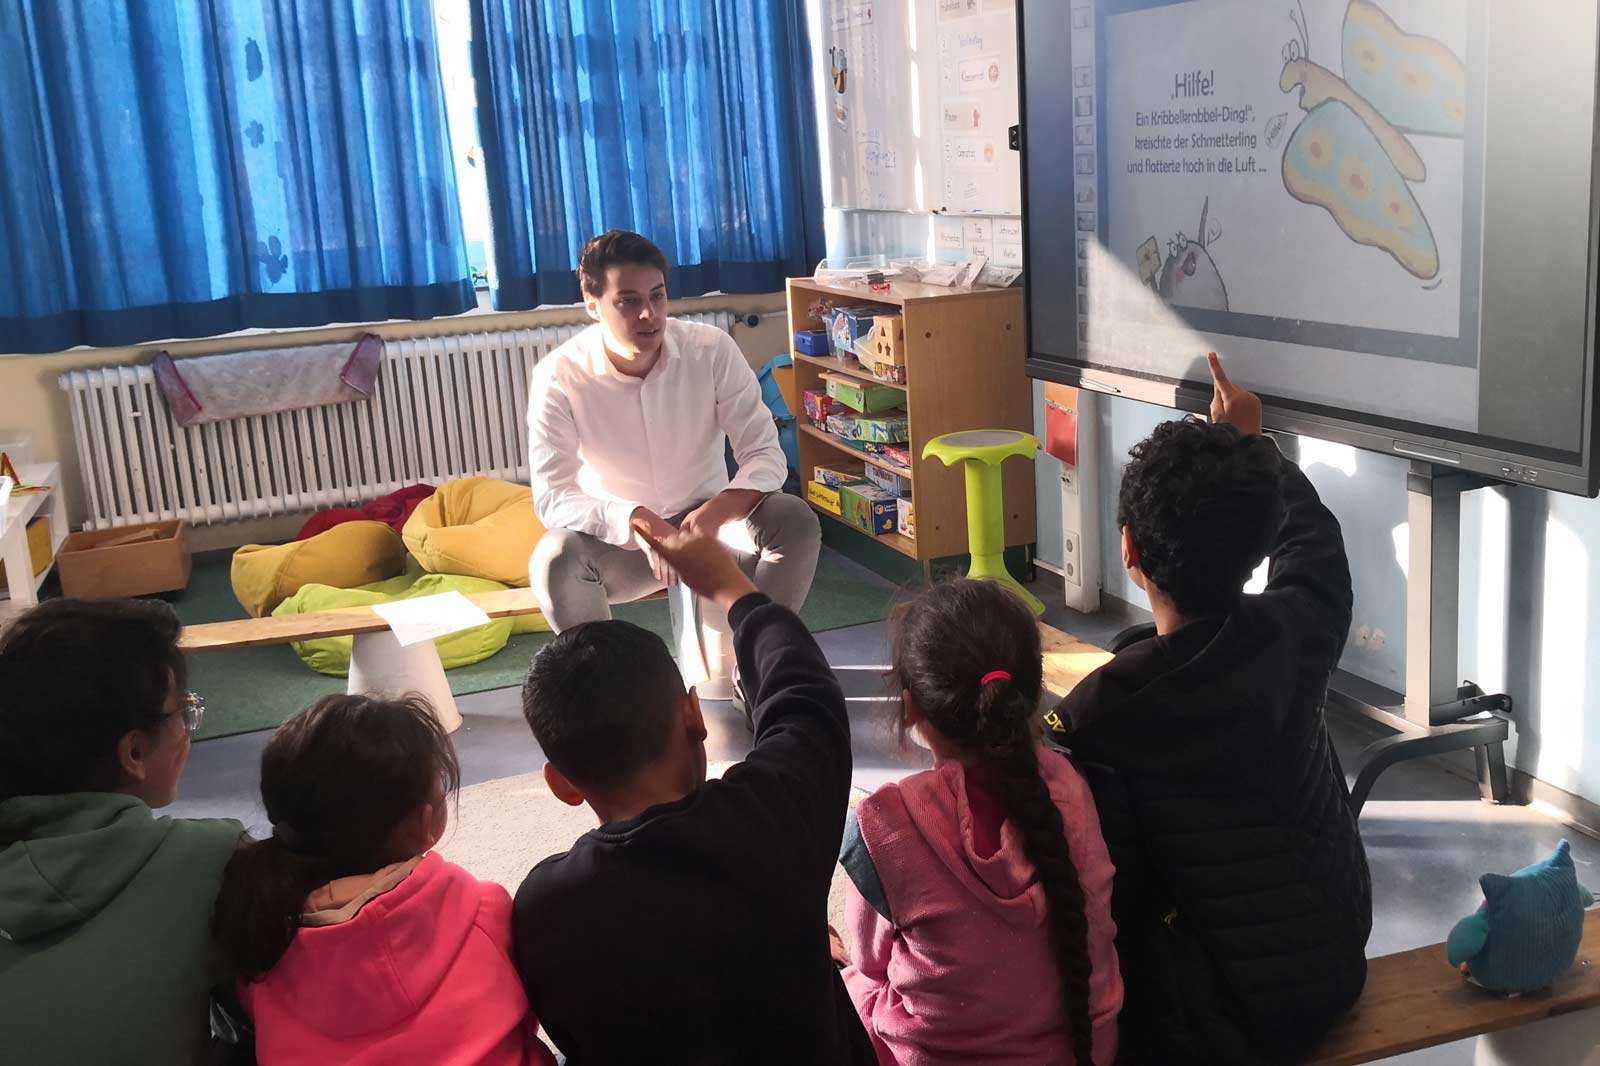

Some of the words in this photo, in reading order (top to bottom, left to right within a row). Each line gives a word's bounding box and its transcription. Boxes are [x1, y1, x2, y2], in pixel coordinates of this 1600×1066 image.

[1136, 112, 1149, 127] Ein
[1135, 136, 1172, 150] kreischte
[1174, 135, 1188, 149] der
[1191, 132, 1257, 150] Schmetterling
[1127, 159, 1143, 174] und
[1145, 158, 1180, 173] flatterte
[1183, 157, 1204, 173] hoch
[1207, 158, 1215, 172] in
[1217, 157, 1233, 173] die
[1235, 156, 1256, 172] Luft
